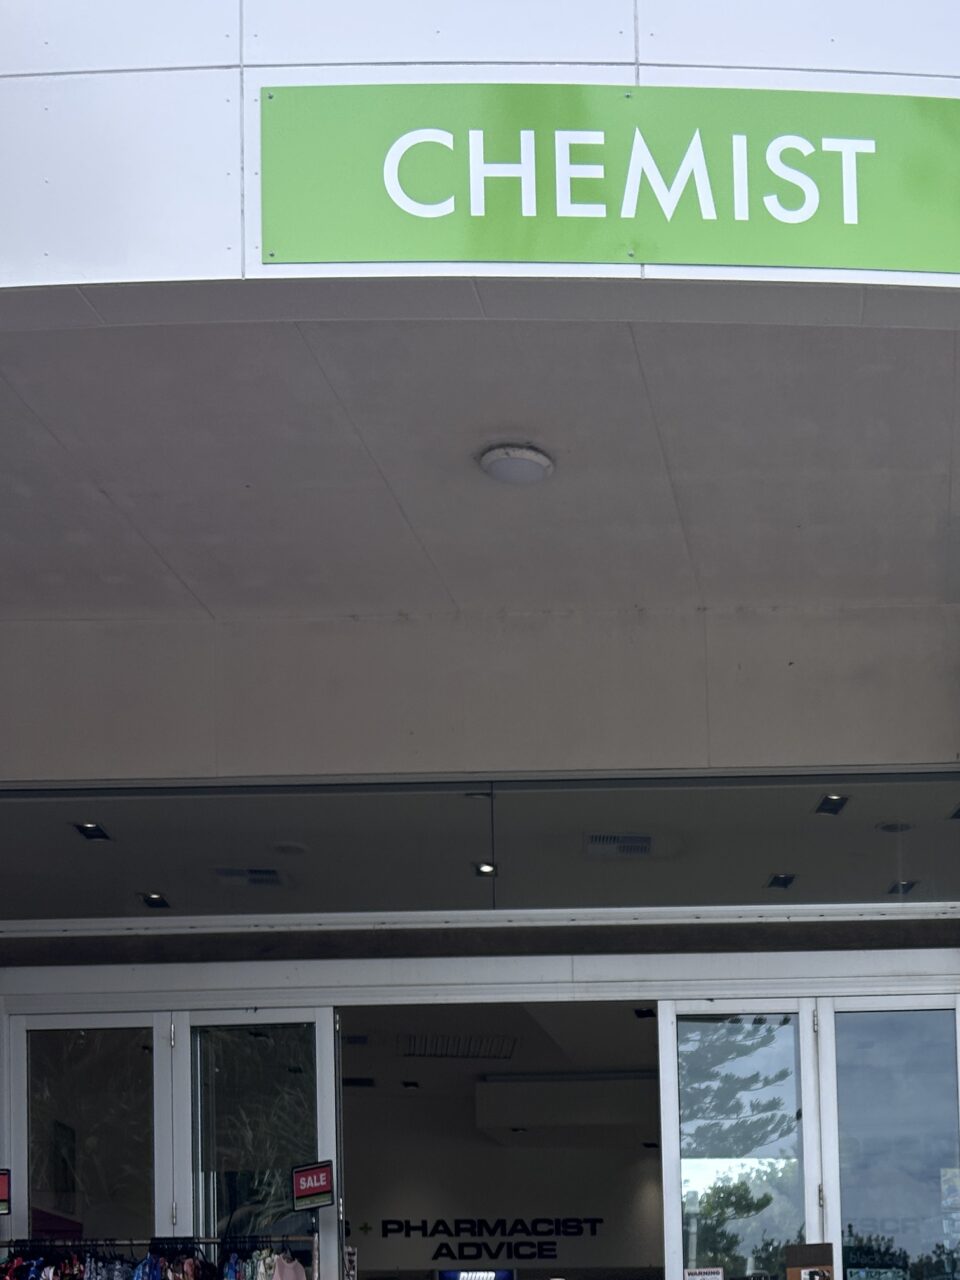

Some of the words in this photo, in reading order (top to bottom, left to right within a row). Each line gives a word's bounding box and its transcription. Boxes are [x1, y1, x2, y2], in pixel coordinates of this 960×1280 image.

[383, 127, 876, 226] CHEMIST
[299, 1172, 327, 1190] SALE
[381, 1217, 603, 1238] PHARMACIST
[431, 1240, 558, 1261] ADVICE
[687, 1270, 721, 1278] WARNING
